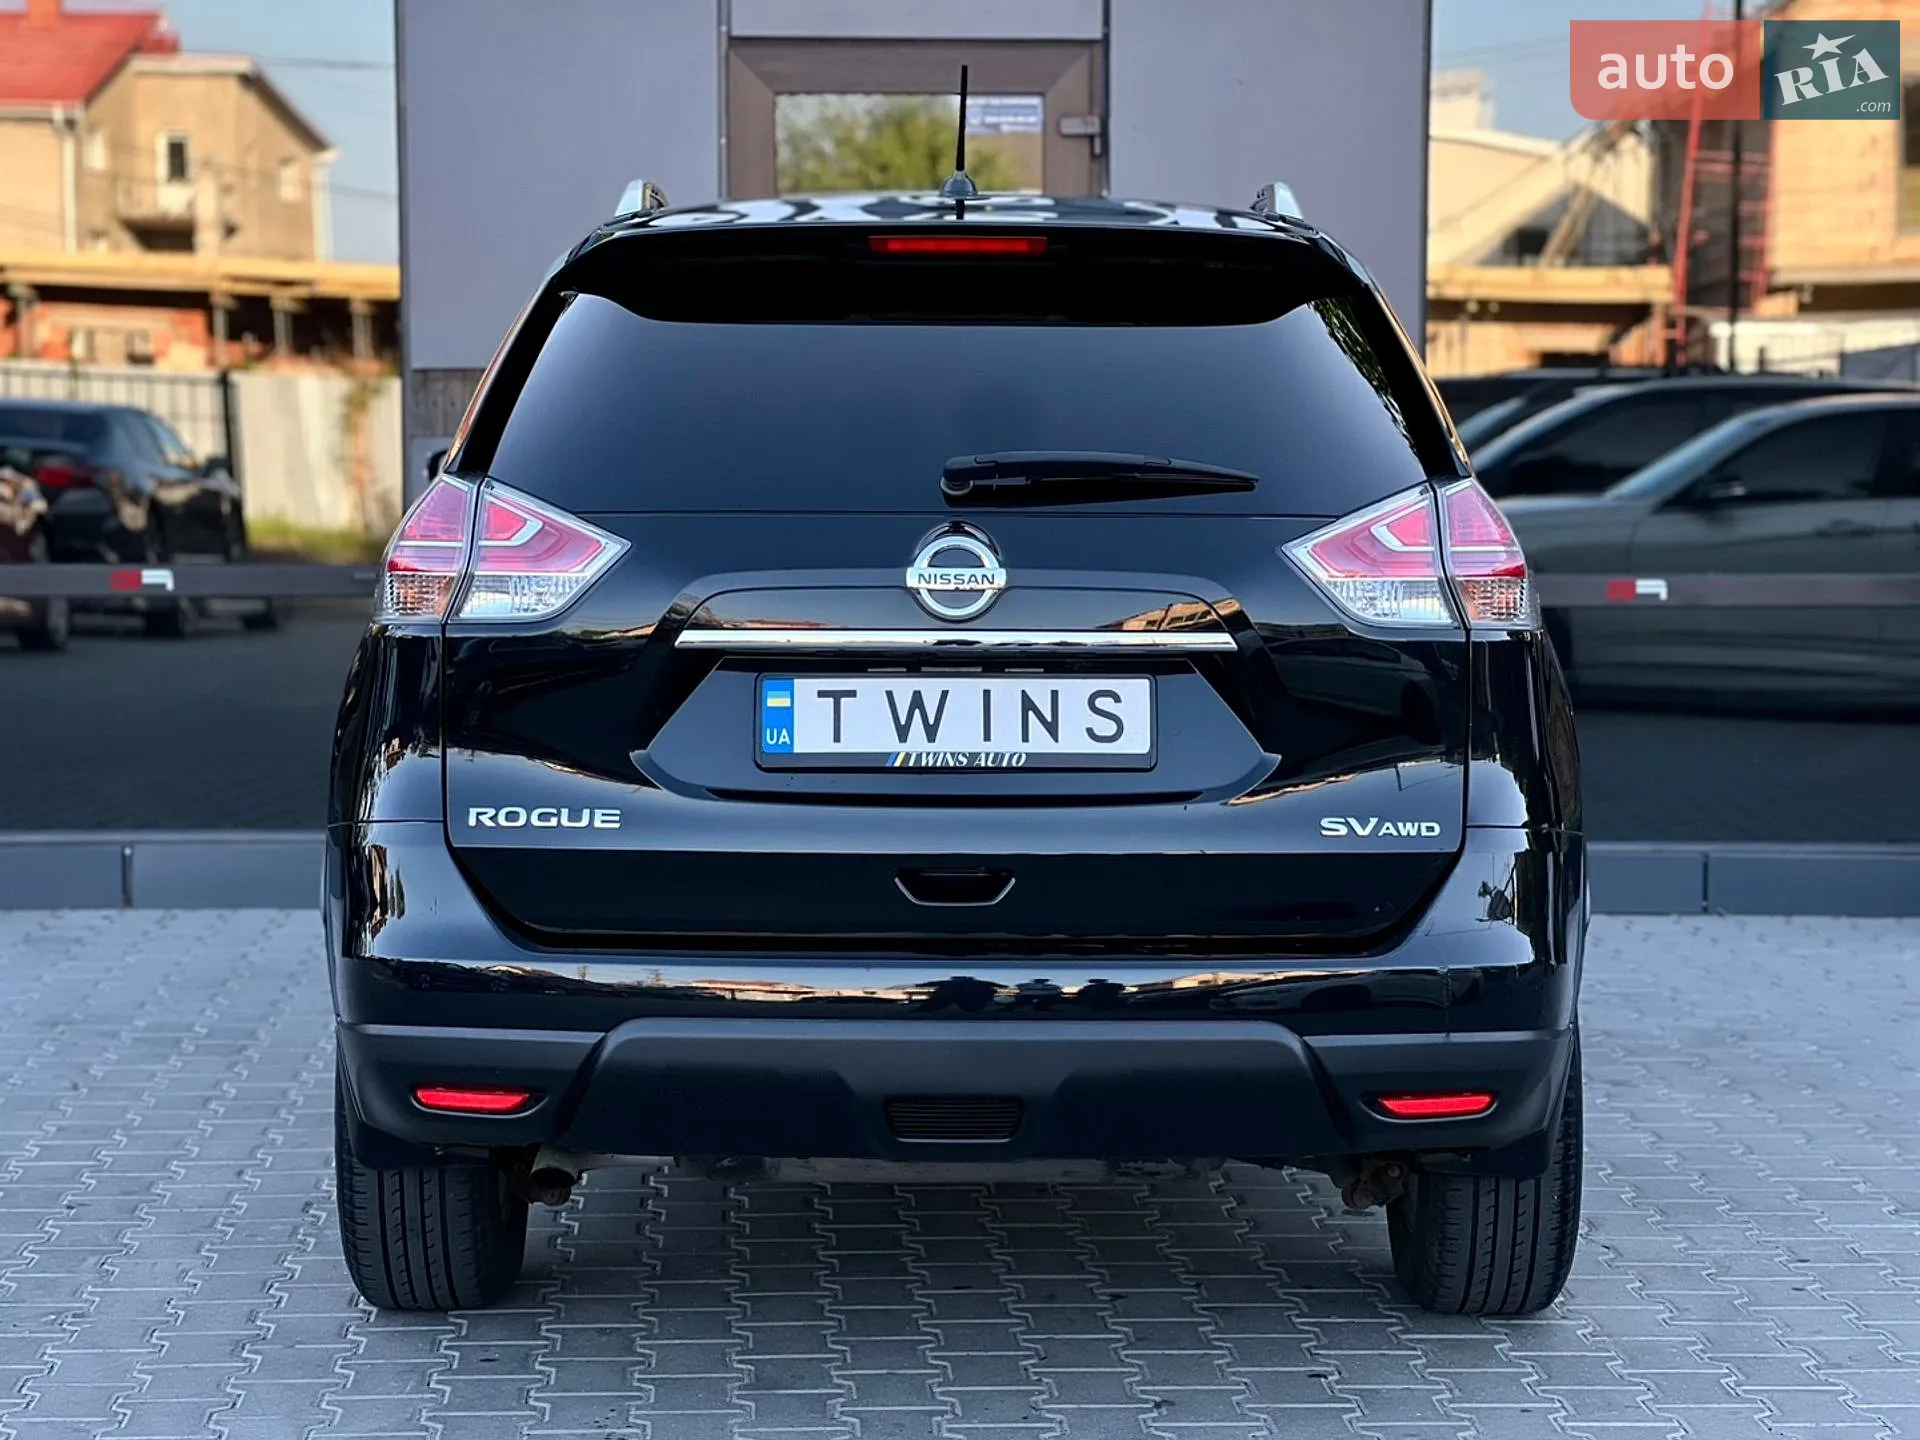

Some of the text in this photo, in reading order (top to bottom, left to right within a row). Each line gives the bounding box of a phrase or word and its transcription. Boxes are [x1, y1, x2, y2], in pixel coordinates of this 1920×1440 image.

[918, 573, 995, 585] NISSAN
[816, 689, 1125, 744] TWINS
[766, 728, 791, 745] UA
[908, 752, 1027, 767] TWINS AUTO
[468, 807, 621, 828] ROGUE
